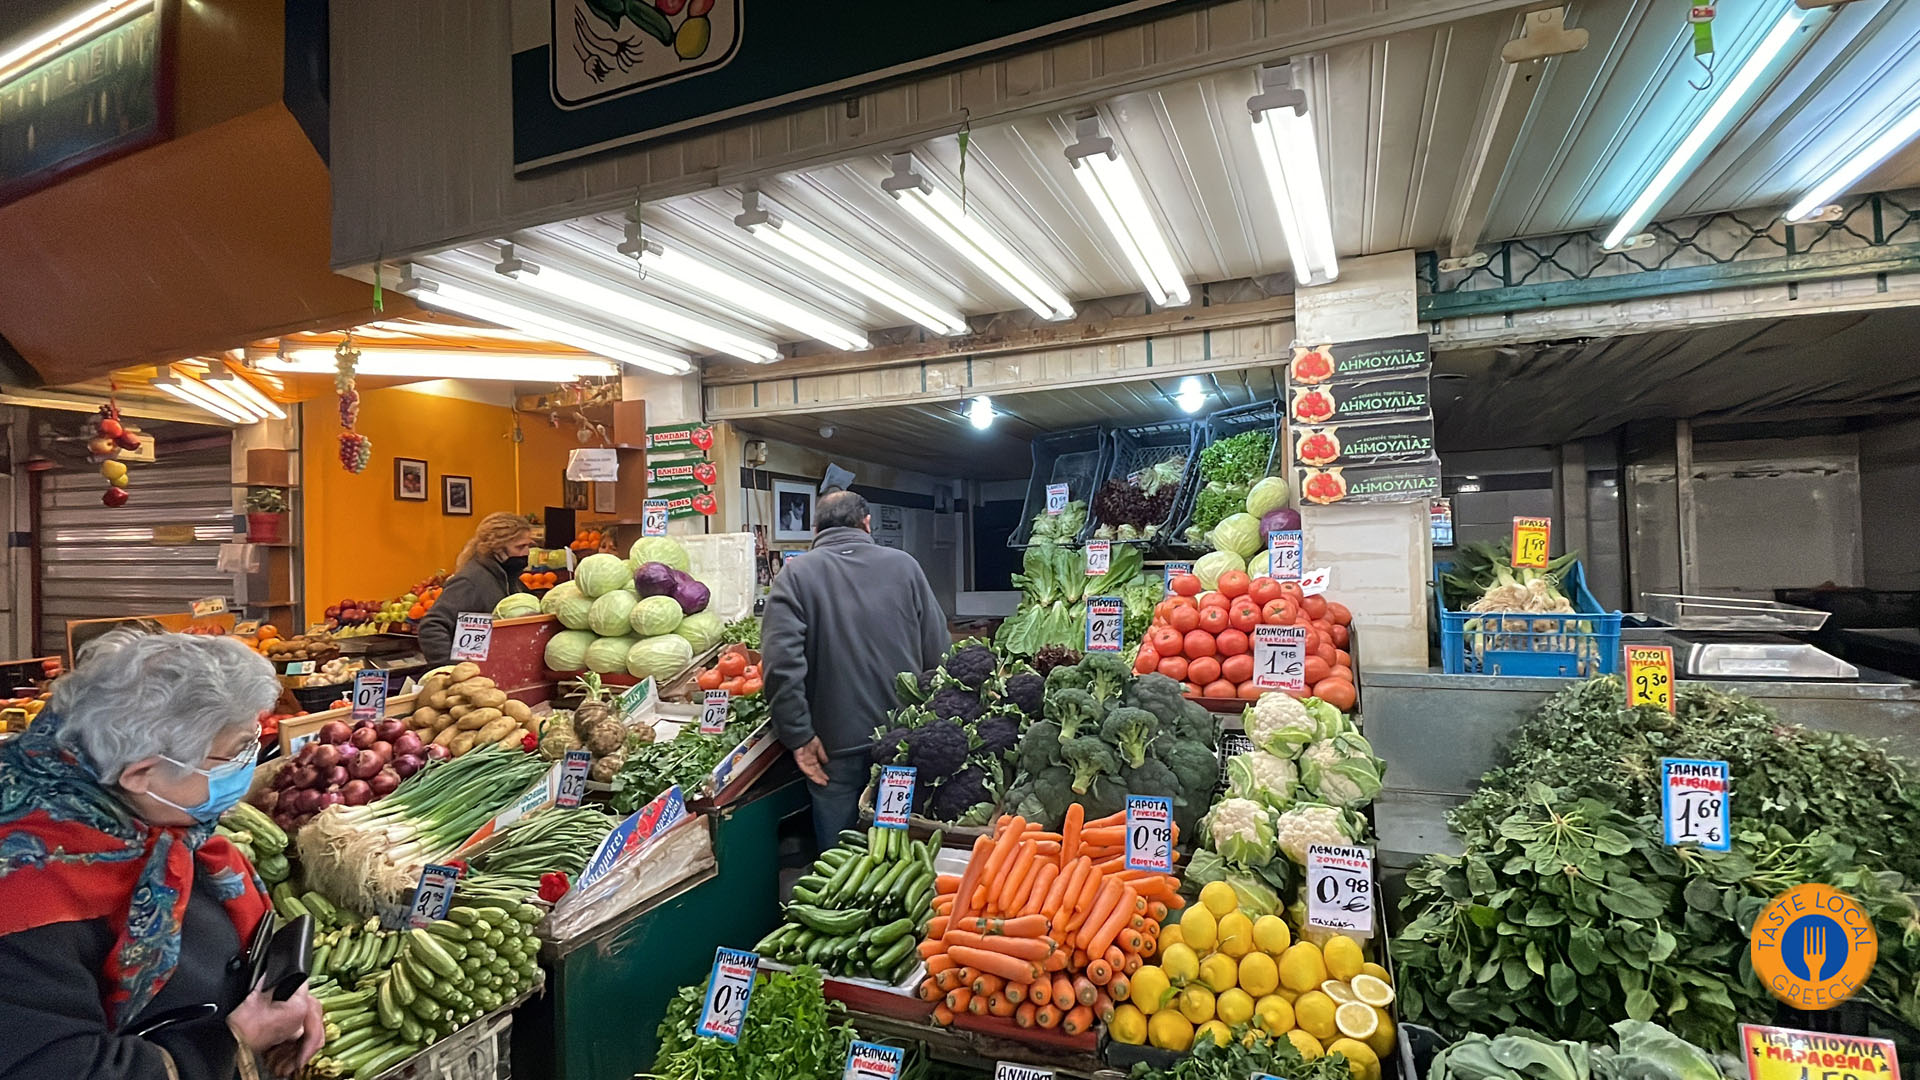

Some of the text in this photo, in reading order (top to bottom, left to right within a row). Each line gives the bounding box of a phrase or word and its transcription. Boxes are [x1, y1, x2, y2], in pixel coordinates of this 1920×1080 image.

[1338, 351, 1425, 371] ΔΗΜΟΥΛΙΑΣ
[1338, 394, 1426, 412] ΔΗΜΟΥΛΙΑΣ
[1343, 438, 1431, 454] ΔΗΜΟΥΛΙΑΣ
[1350, 477, 1438, 493] ΔΗΜΟΥΛΙΑΣ
[1665, 763, 1724, 778] ΣΠΑΝΑΚΙ
[1128, 799, 1168, 811] ΚΑΡΟΤΑ
